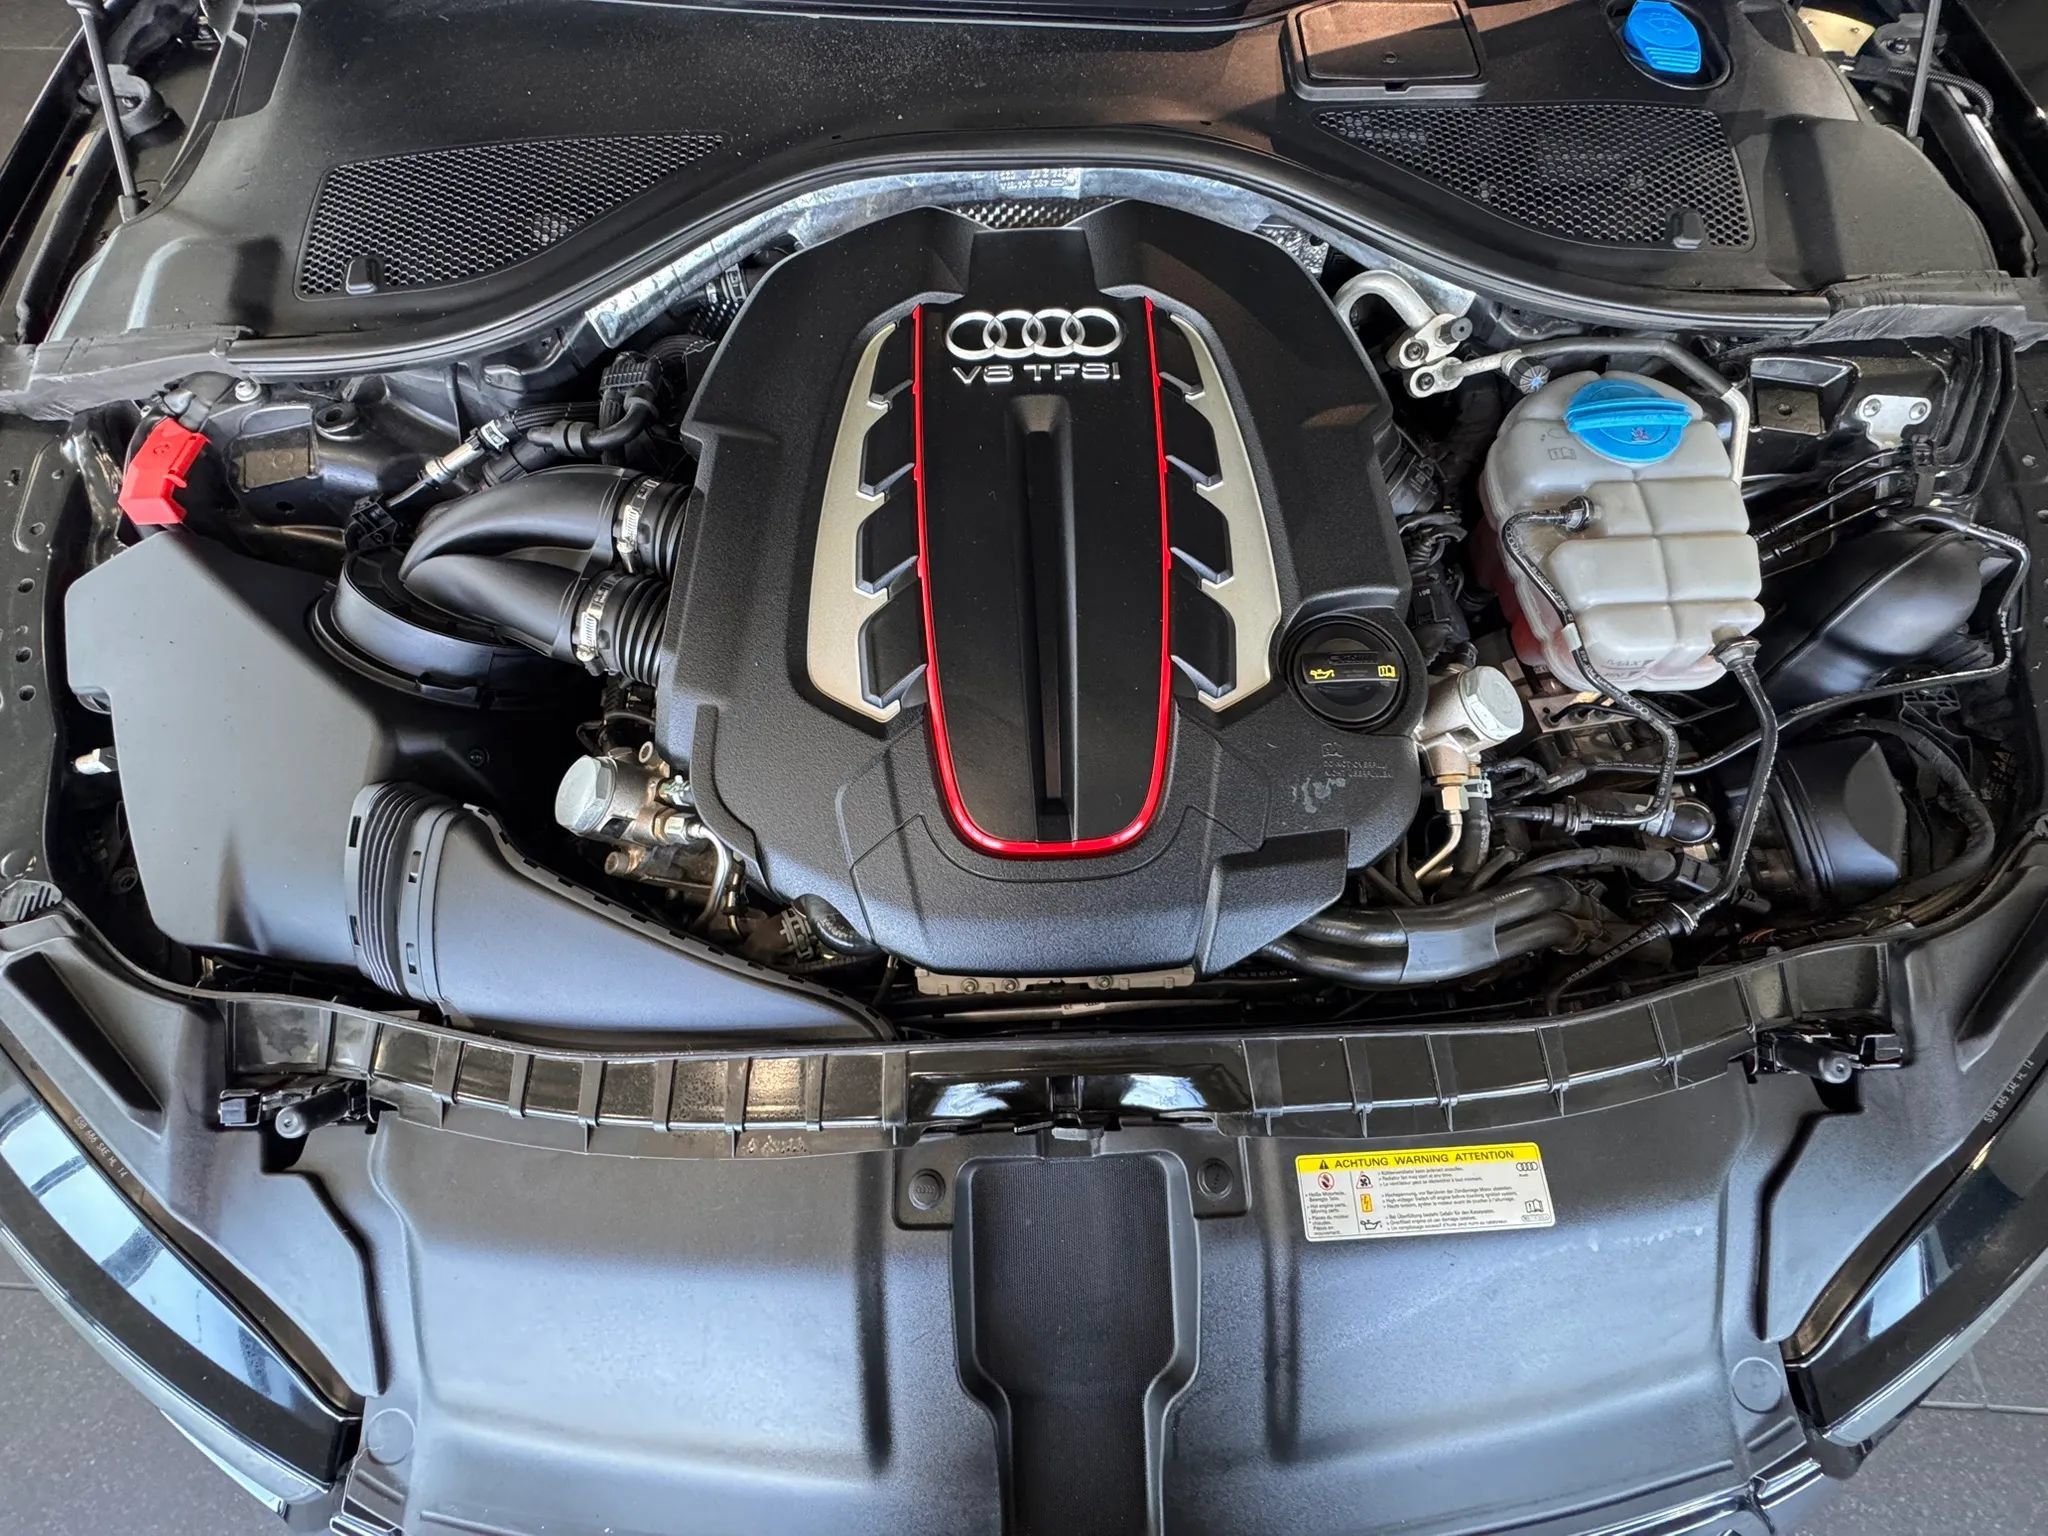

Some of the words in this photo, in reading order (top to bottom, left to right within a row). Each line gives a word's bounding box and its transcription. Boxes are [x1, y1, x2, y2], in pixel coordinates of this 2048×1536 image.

[953, 364, 1014, 384] V8
[1335, 1156, 1389, 1169] ACHTUNG
[1394, 1153, 1449, 1166] WARNING
[1454, 1150, 1514, 1162] ATTENTION
